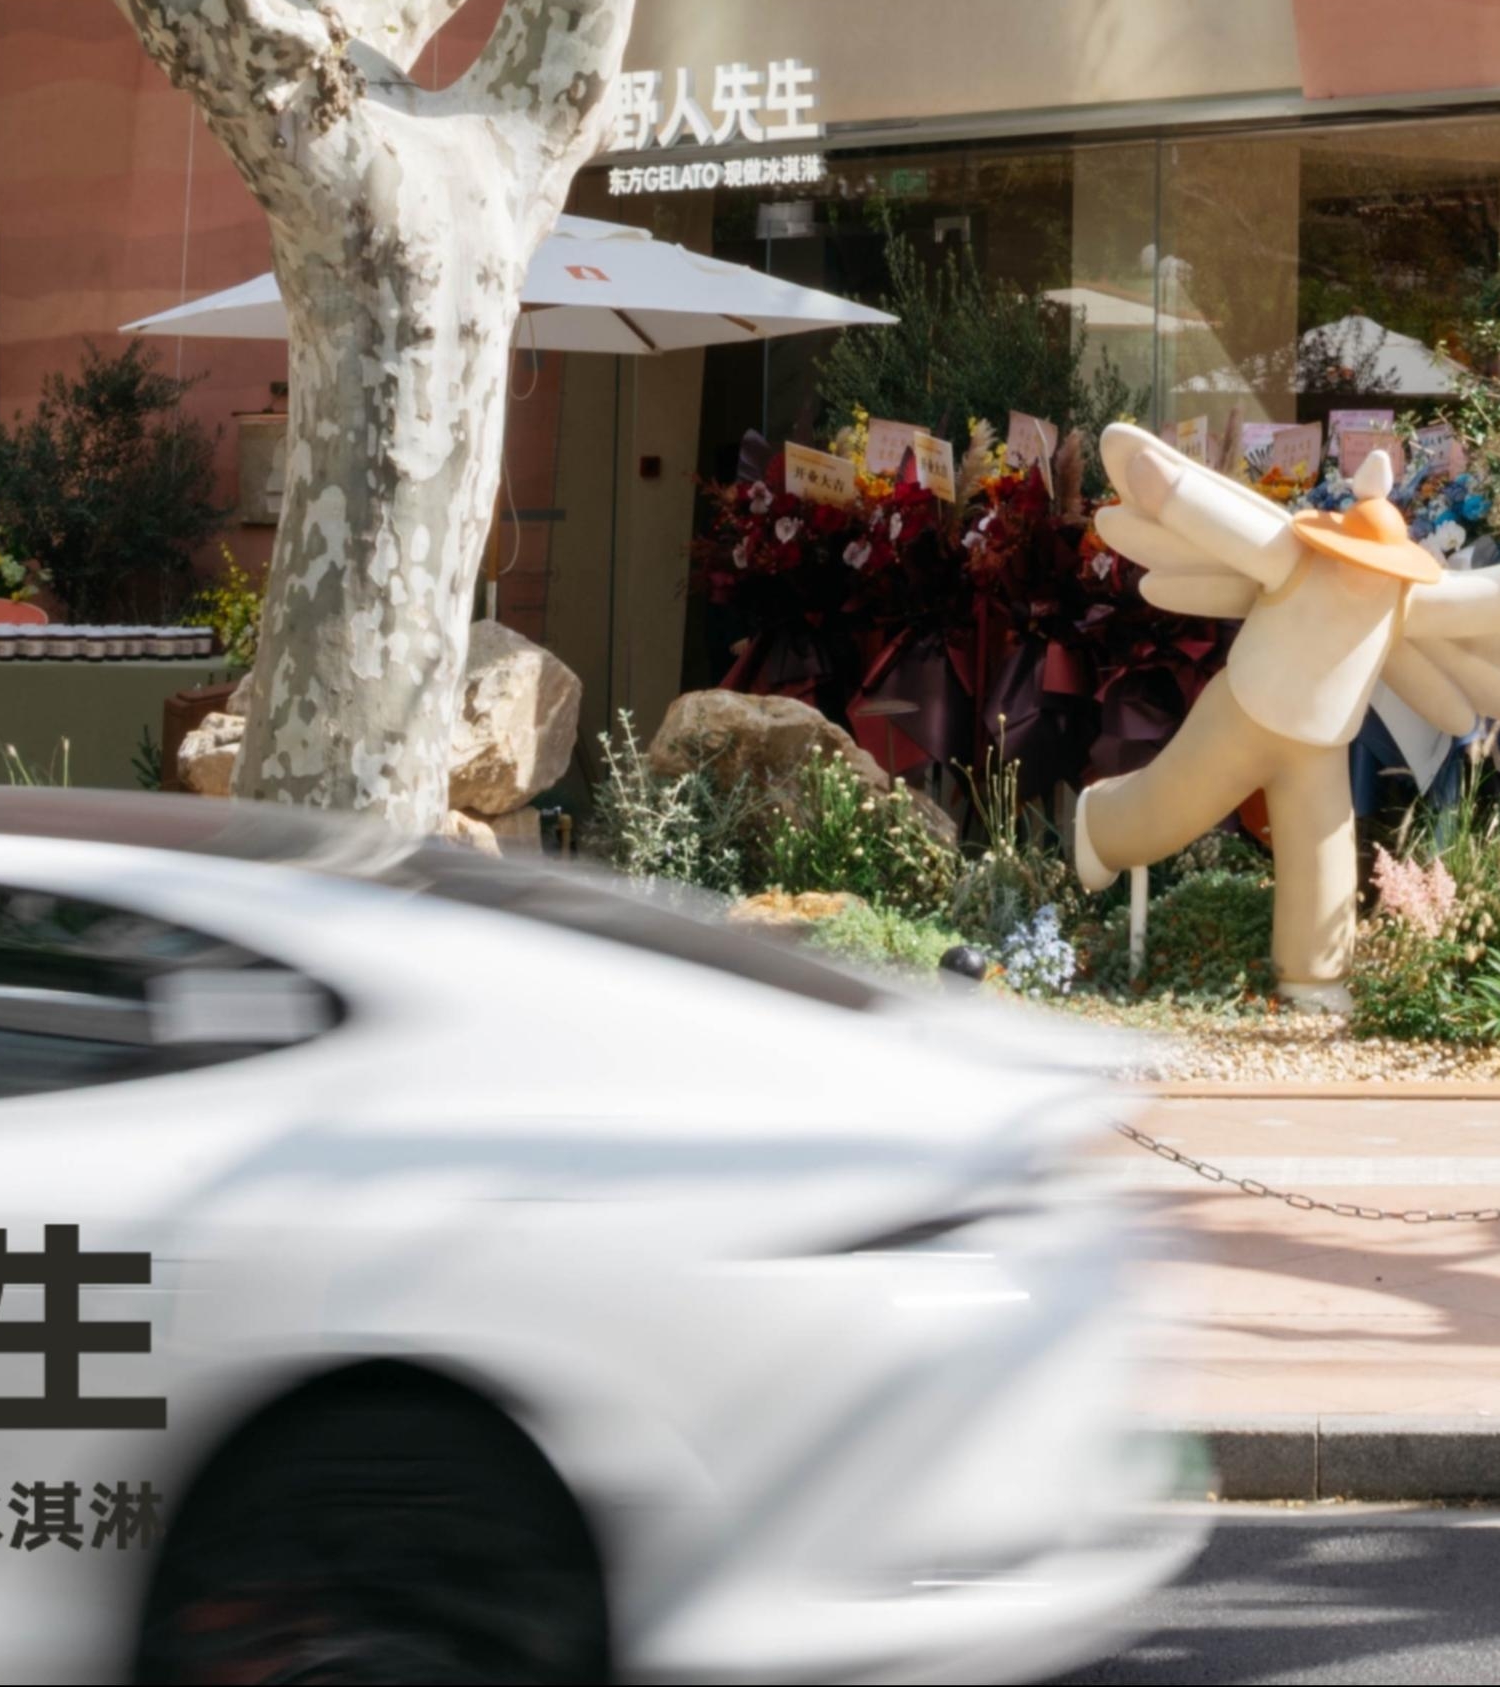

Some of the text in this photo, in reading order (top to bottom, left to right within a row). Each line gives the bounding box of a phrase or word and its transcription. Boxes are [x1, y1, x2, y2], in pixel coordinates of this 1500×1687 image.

[608, 59, 823, 152] 野人先生
[608, 154, 826, 196] 东方GELATO 现做冰淇淋
